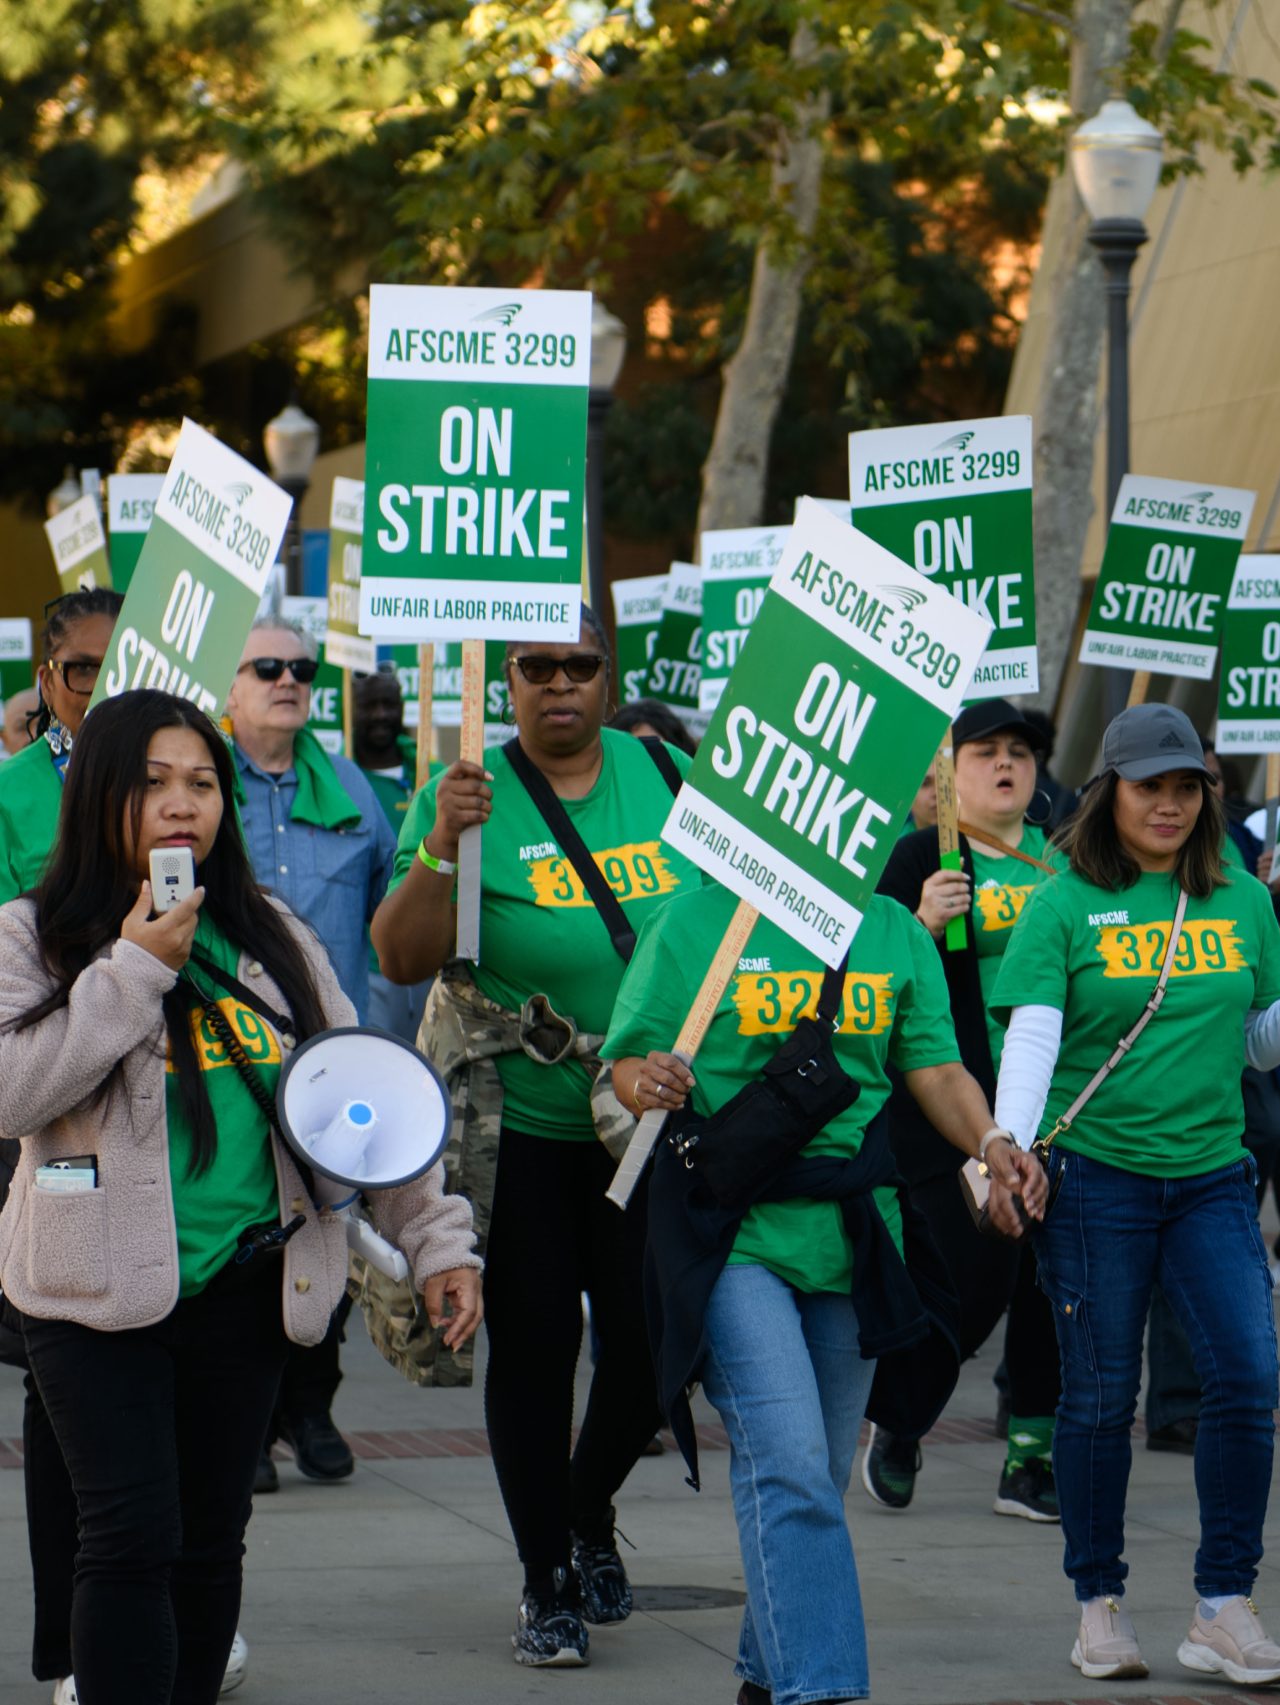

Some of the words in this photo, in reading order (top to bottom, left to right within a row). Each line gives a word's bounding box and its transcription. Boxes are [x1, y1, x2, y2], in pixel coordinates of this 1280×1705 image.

[385, 328, 497, 364] AFSCME
[505, 332, 577, 368] 3299
[439, 405, 513, 477] ON
[864, 456, 955, 493] AFSCME
[962, 450, 1021, 481] 3299
[120, 501, 155, 520] AFS
[169, 469, 230, 542] AFSCME
[227, 513, 271, 571] 3299
[377, 483, 571, 559] STRIKE
[1123, 497, 1194, 523] AFSCME
[1195, 506, 1242, 530] 3299
[710, 550, 764, 571] AFSCME
[768, 549, 783, 567] 32
[913, 515, 973, 576] ON
[1145, 542, 1197, 586] ON
[161, 569, 215, 663] ON
[371, 596, 430, 619] UNFAIR
[434, 599, 487, 621] LABOR
[491, 601, 571, 624] PRACTICE
[790, 550, 895, 643] AFSCME
[891, 620, 961, 690] 3299
[1099, 581, 1222, 633] STRIKE
[973, 661, 1029, 684] RACTICE
[1087, 640, 1125, 656] UNFAIR
[1125, 646, 1159, 661] LABOR
[1160, 650, 1209, 668] PRACTICE
[793, 662, 877, 766] ON
[711, 705, 892, 880] STRIKE
[549, 853, 661, 901] 399
[678, 807, 731, 860] UNFAIR
[728, 845, 777, 895] LABOR
[775, 879, 846, 946] PRACTICE
[1088, 910, 1130, 927] AFSCME
[738, 956, 772, 972] SCME
[1116, 928, 1227, 972] 3299
[756, 976, 876, 1031] 329
[201, 1008, 271, 1063] 99
